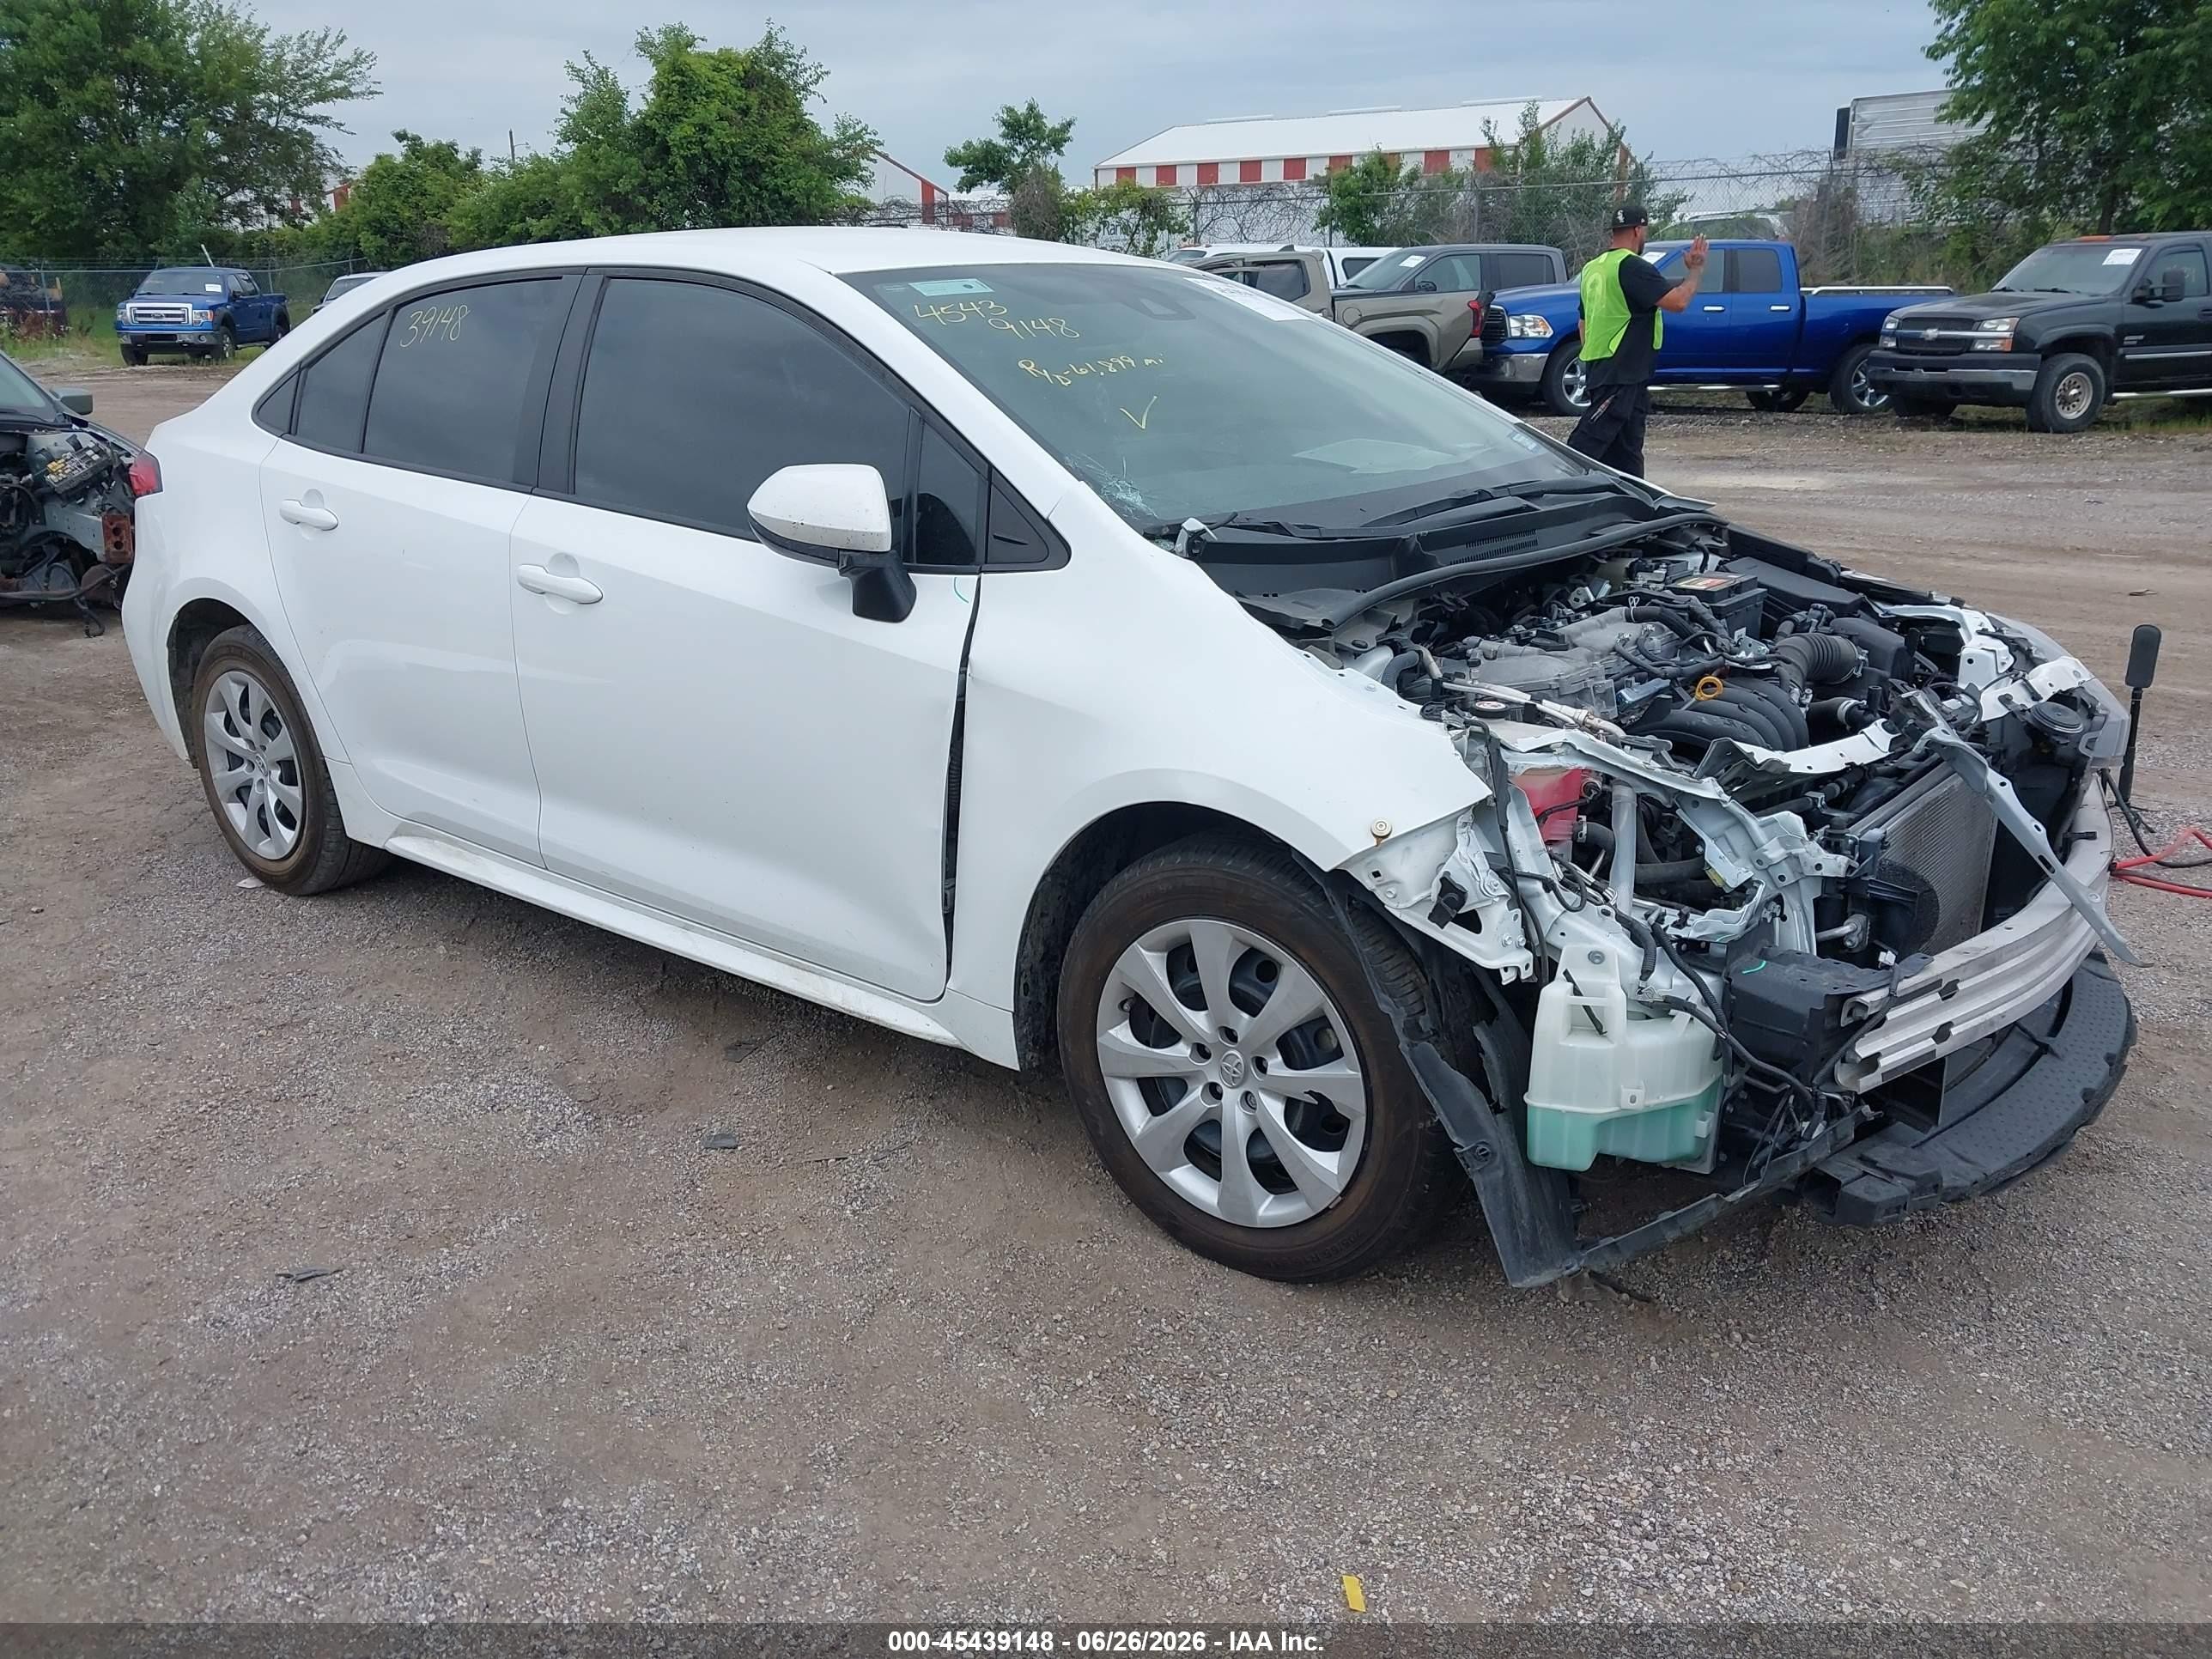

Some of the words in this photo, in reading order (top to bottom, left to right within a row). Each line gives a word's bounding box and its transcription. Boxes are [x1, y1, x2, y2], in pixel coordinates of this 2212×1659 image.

[914, 299, 1007, 325] 4543
[399, 304, 471, 348] 39148
[988, 317, 1080, 340] 9148
